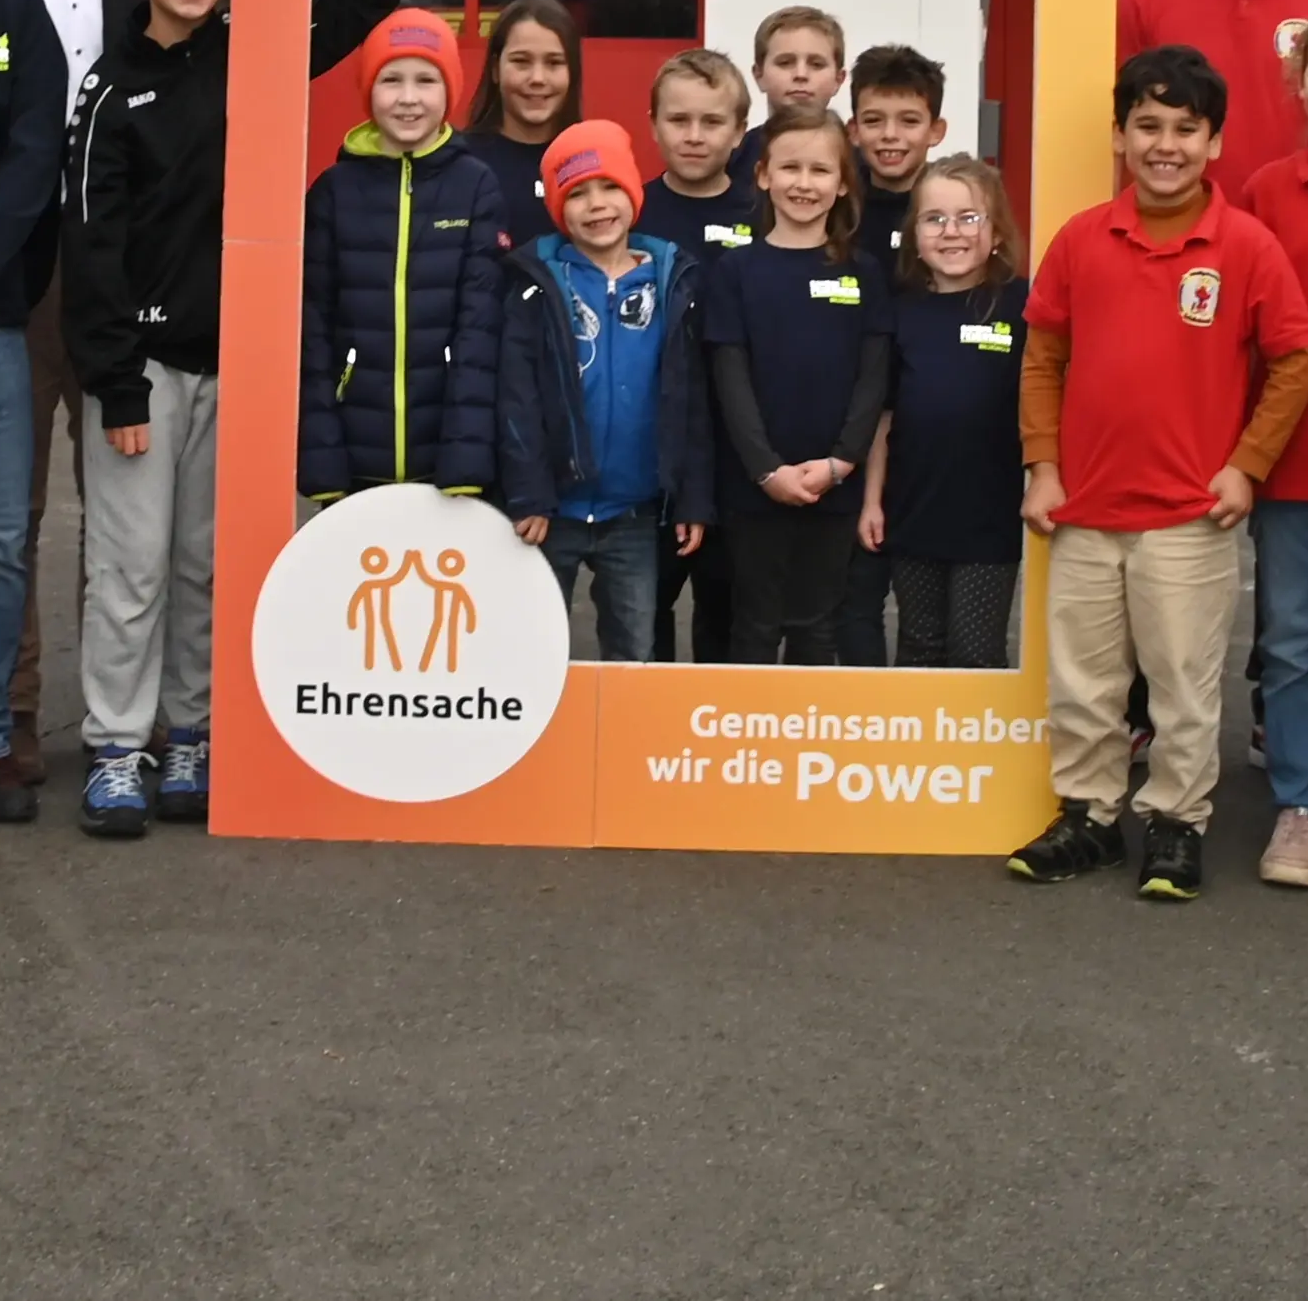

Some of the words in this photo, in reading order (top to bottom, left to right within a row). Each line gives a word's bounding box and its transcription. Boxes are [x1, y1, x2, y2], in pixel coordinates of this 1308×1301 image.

[295, 682, 523, 722] Ehrensache
[689, 704, 924, 743] Gemeinsam
[646, 751, 713, 785] wir
[721, 750, 783, 786] die
[796, 752, 995, 804] Power
